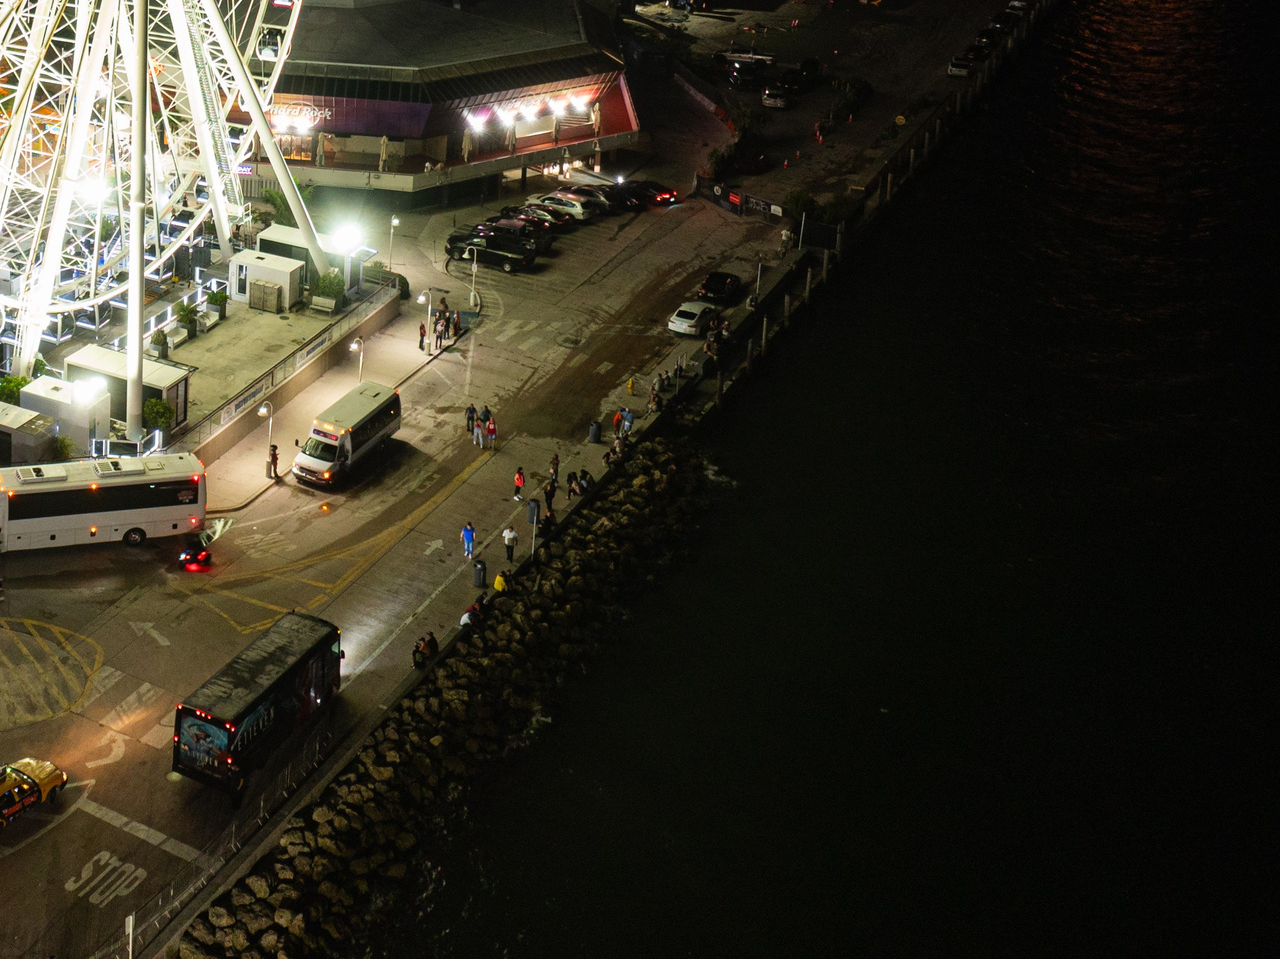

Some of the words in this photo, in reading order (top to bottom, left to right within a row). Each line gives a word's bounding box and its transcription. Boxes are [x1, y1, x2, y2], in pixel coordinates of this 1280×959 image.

[269, 105, 300, 117] Hard
[301, 107, 332, 120] Rock
[64, 850, 148, 909] STOP
